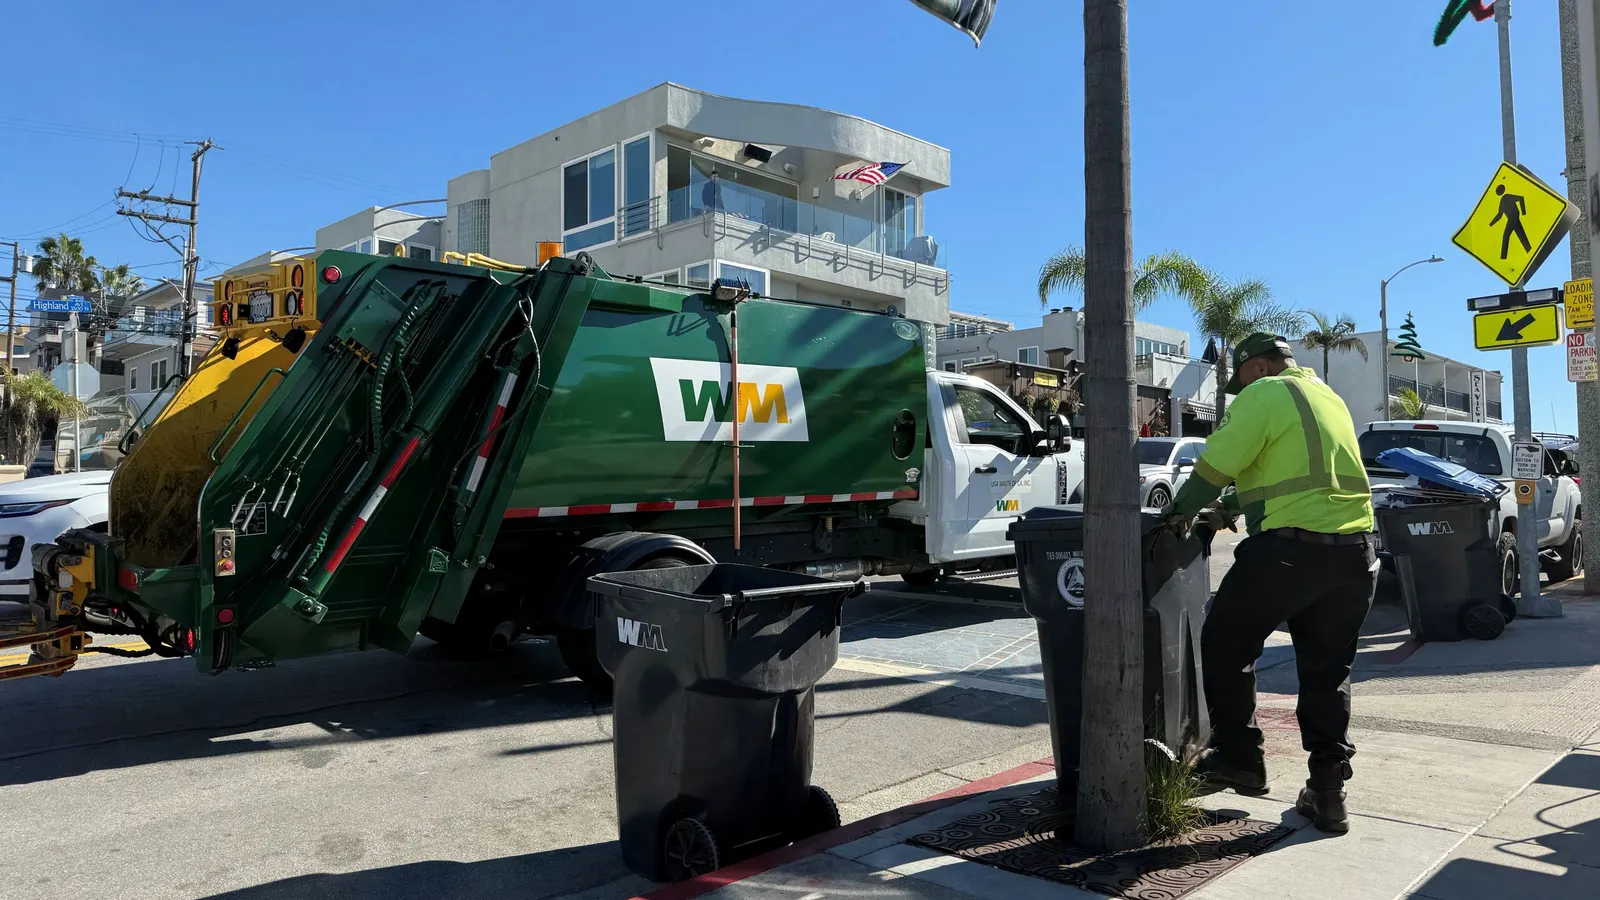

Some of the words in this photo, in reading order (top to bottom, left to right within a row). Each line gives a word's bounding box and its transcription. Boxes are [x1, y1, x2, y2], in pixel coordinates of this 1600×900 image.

[1566, 283, 1593, 294] LOADIN
[1573, 294, 1593, 304] ZONE
[33, 300, 69, 311] Highland
[1567, 305, 1580, 314] 7AM
[1568, 335, 1582, 346] NO
[1571, 347, 1597, 357] PARKIN
[678, 378, 789, 424] WM
[991, 480, 999, 488] USA
[996, 499, 1019, 512] WM
[1406, 520, 1455, 536] WM
[617, 616, 668, 653] WM
